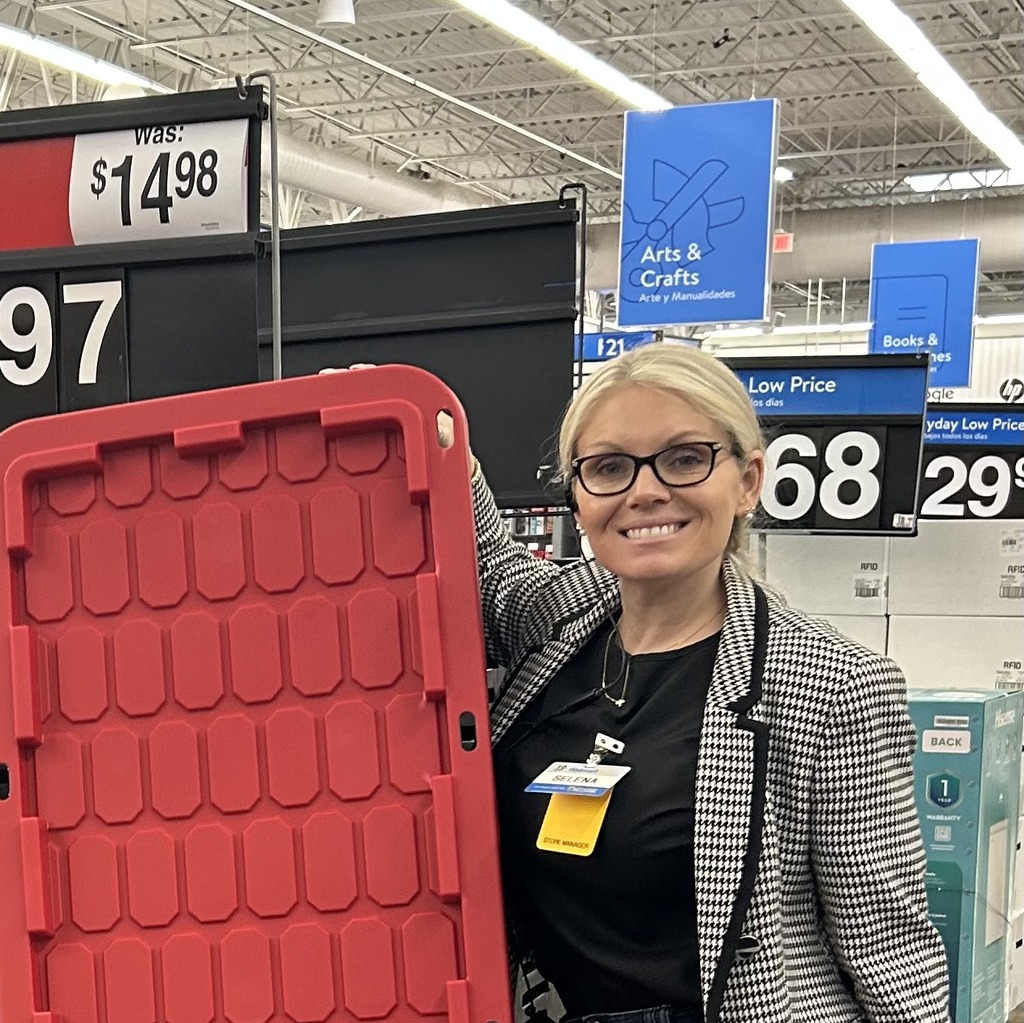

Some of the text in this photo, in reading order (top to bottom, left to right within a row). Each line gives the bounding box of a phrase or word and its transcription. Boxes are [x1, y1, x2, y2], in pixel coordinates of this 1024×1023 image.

[640, 242, 701, 263] Arts &
[640, 268, 700, 288] Crafts
[639, 290, 736, 304] Arte y Manualidades
[883, 333, 938, 347] Books &
[749, 376, 836, 393] Low Price
[962, 417, 989, 430] Low
[993, 418, 1024, 431] Price
[860, 562, 878, 571] RFID
[1004, 661, 1021, 670] RFID
[930, 737, 962, 747] BACK
[940, 779, 948, 797] 1
[562, 840, 589, 849] MANAGER
